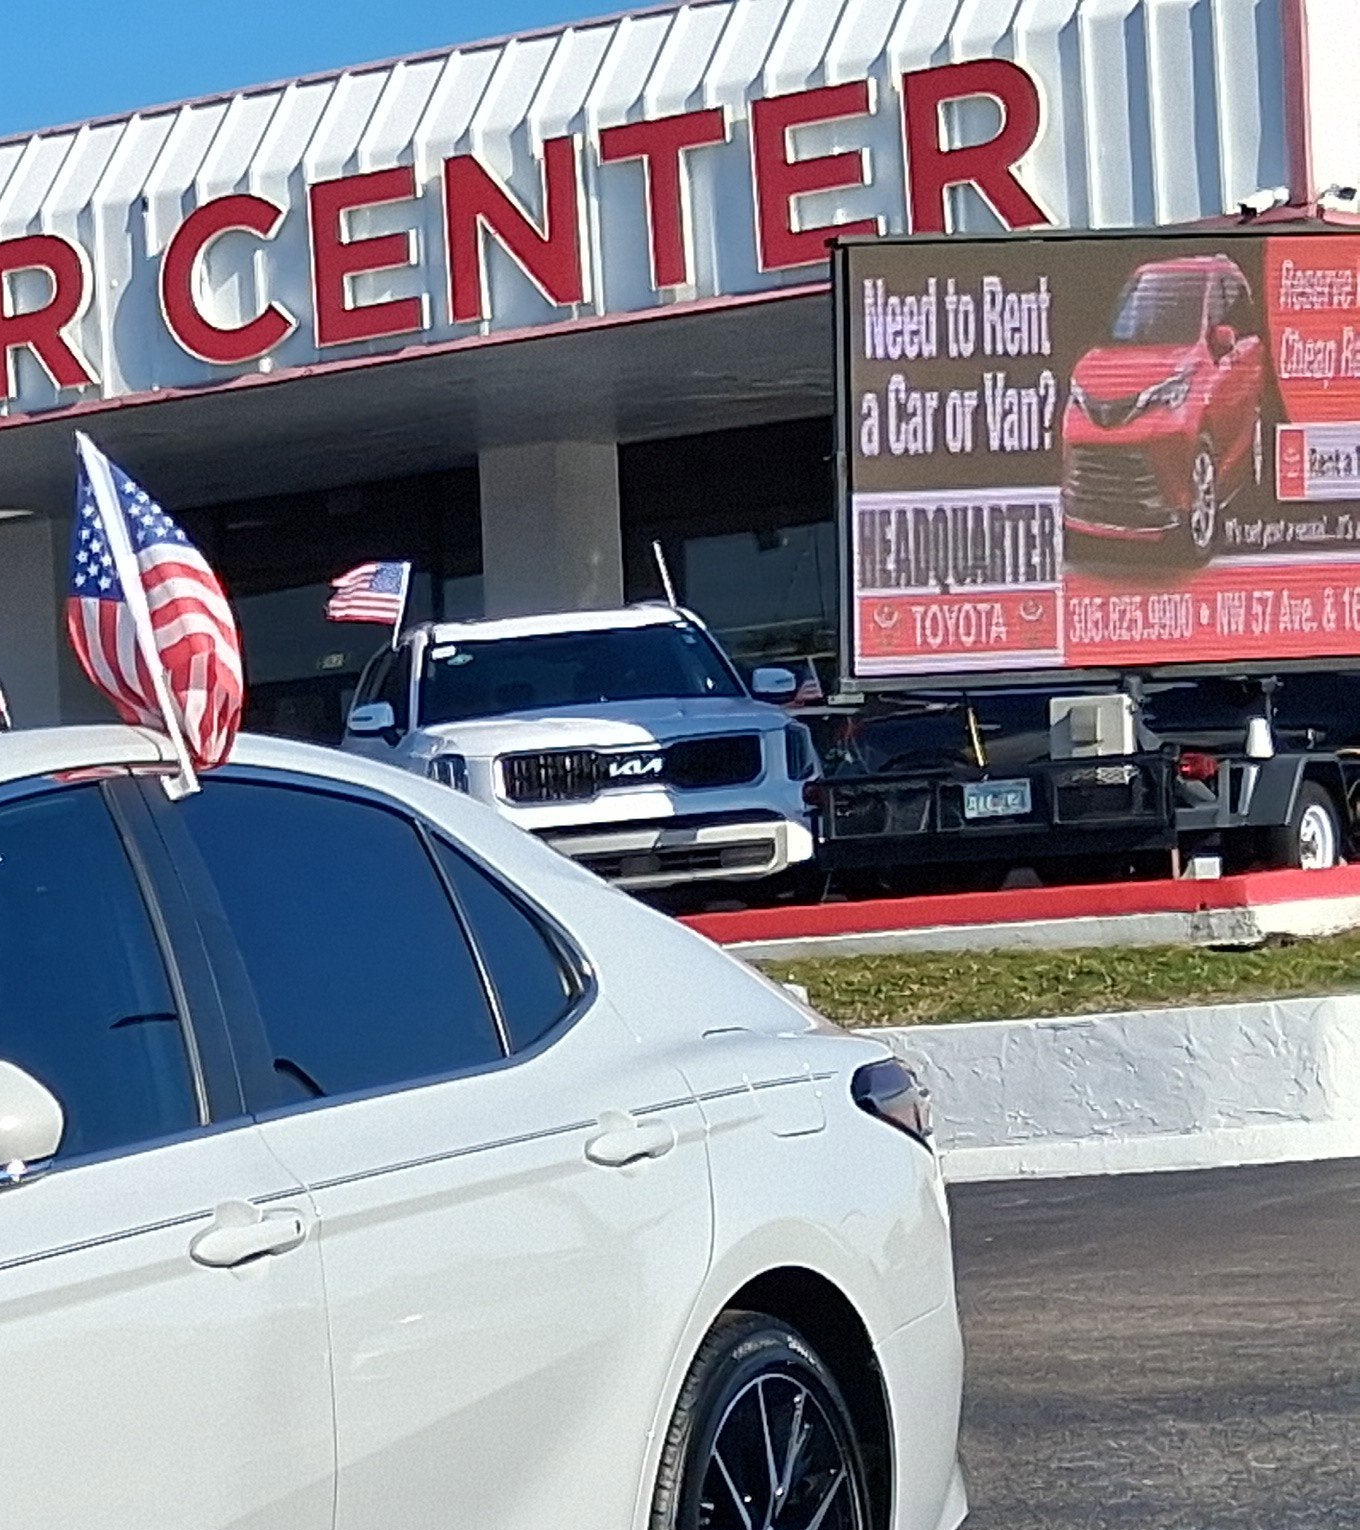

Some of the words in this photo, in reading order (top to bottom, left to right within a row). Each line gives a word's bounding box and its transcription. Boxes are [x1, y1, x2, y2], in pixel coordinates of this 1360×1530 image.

[159, 57, 1058, 366] CENTER
[863, 277, 937, 359] Need
[945, 277, 976, 358] to
[983, 275, 1051, 357] Rent
[861, 392, 879, 456] a
[887, 373, 939, 456] Car
[945, 389, 978, 453] or
[983, 369, 1056, 451] Van?
[910, 602, 1007, 649] TOYOTA
[1216, 591, 1245, 635] NW
[1252, 591, 1274, 635] 57
